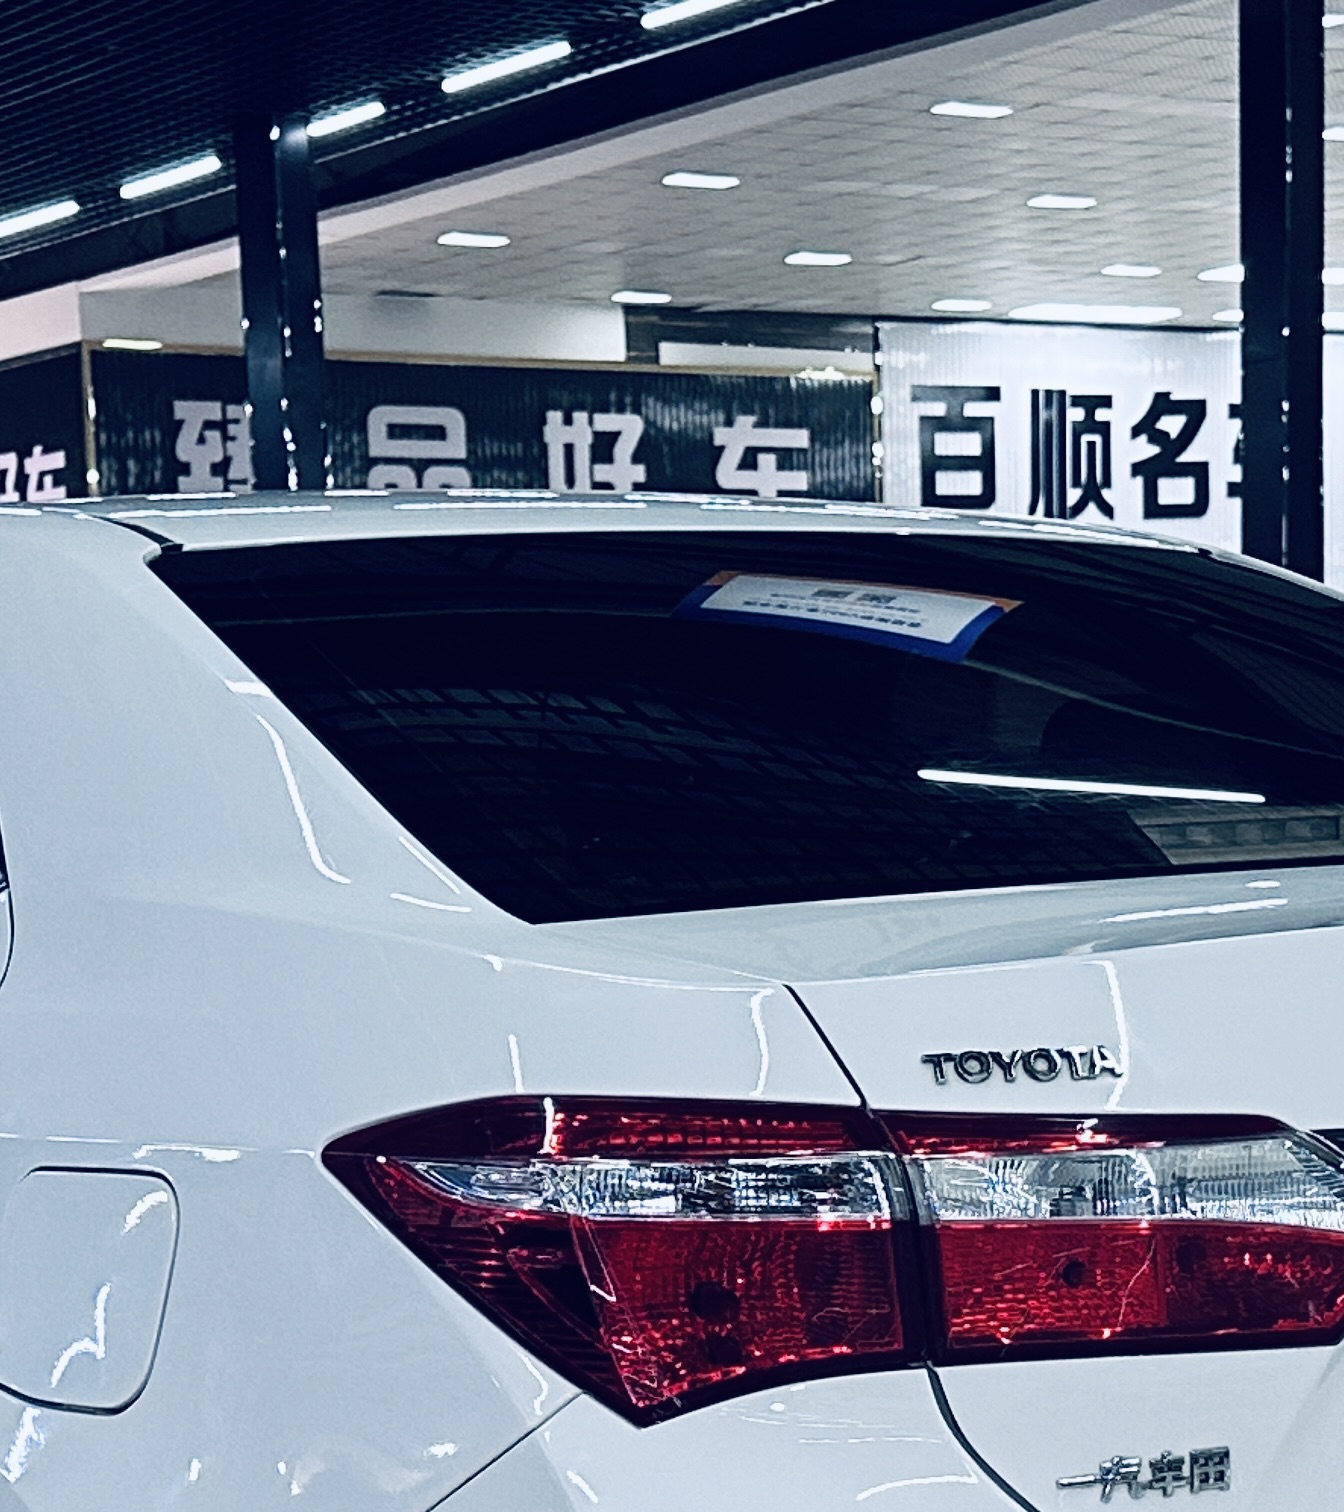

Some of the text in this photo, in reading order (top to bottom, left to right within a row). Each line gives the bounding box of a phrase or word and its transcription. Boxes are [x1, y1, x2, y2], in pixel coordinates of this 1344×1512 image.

[910, 385, 1242, 521] 百顺名
[920, 1044, 1124, 1086] TOYOTA
